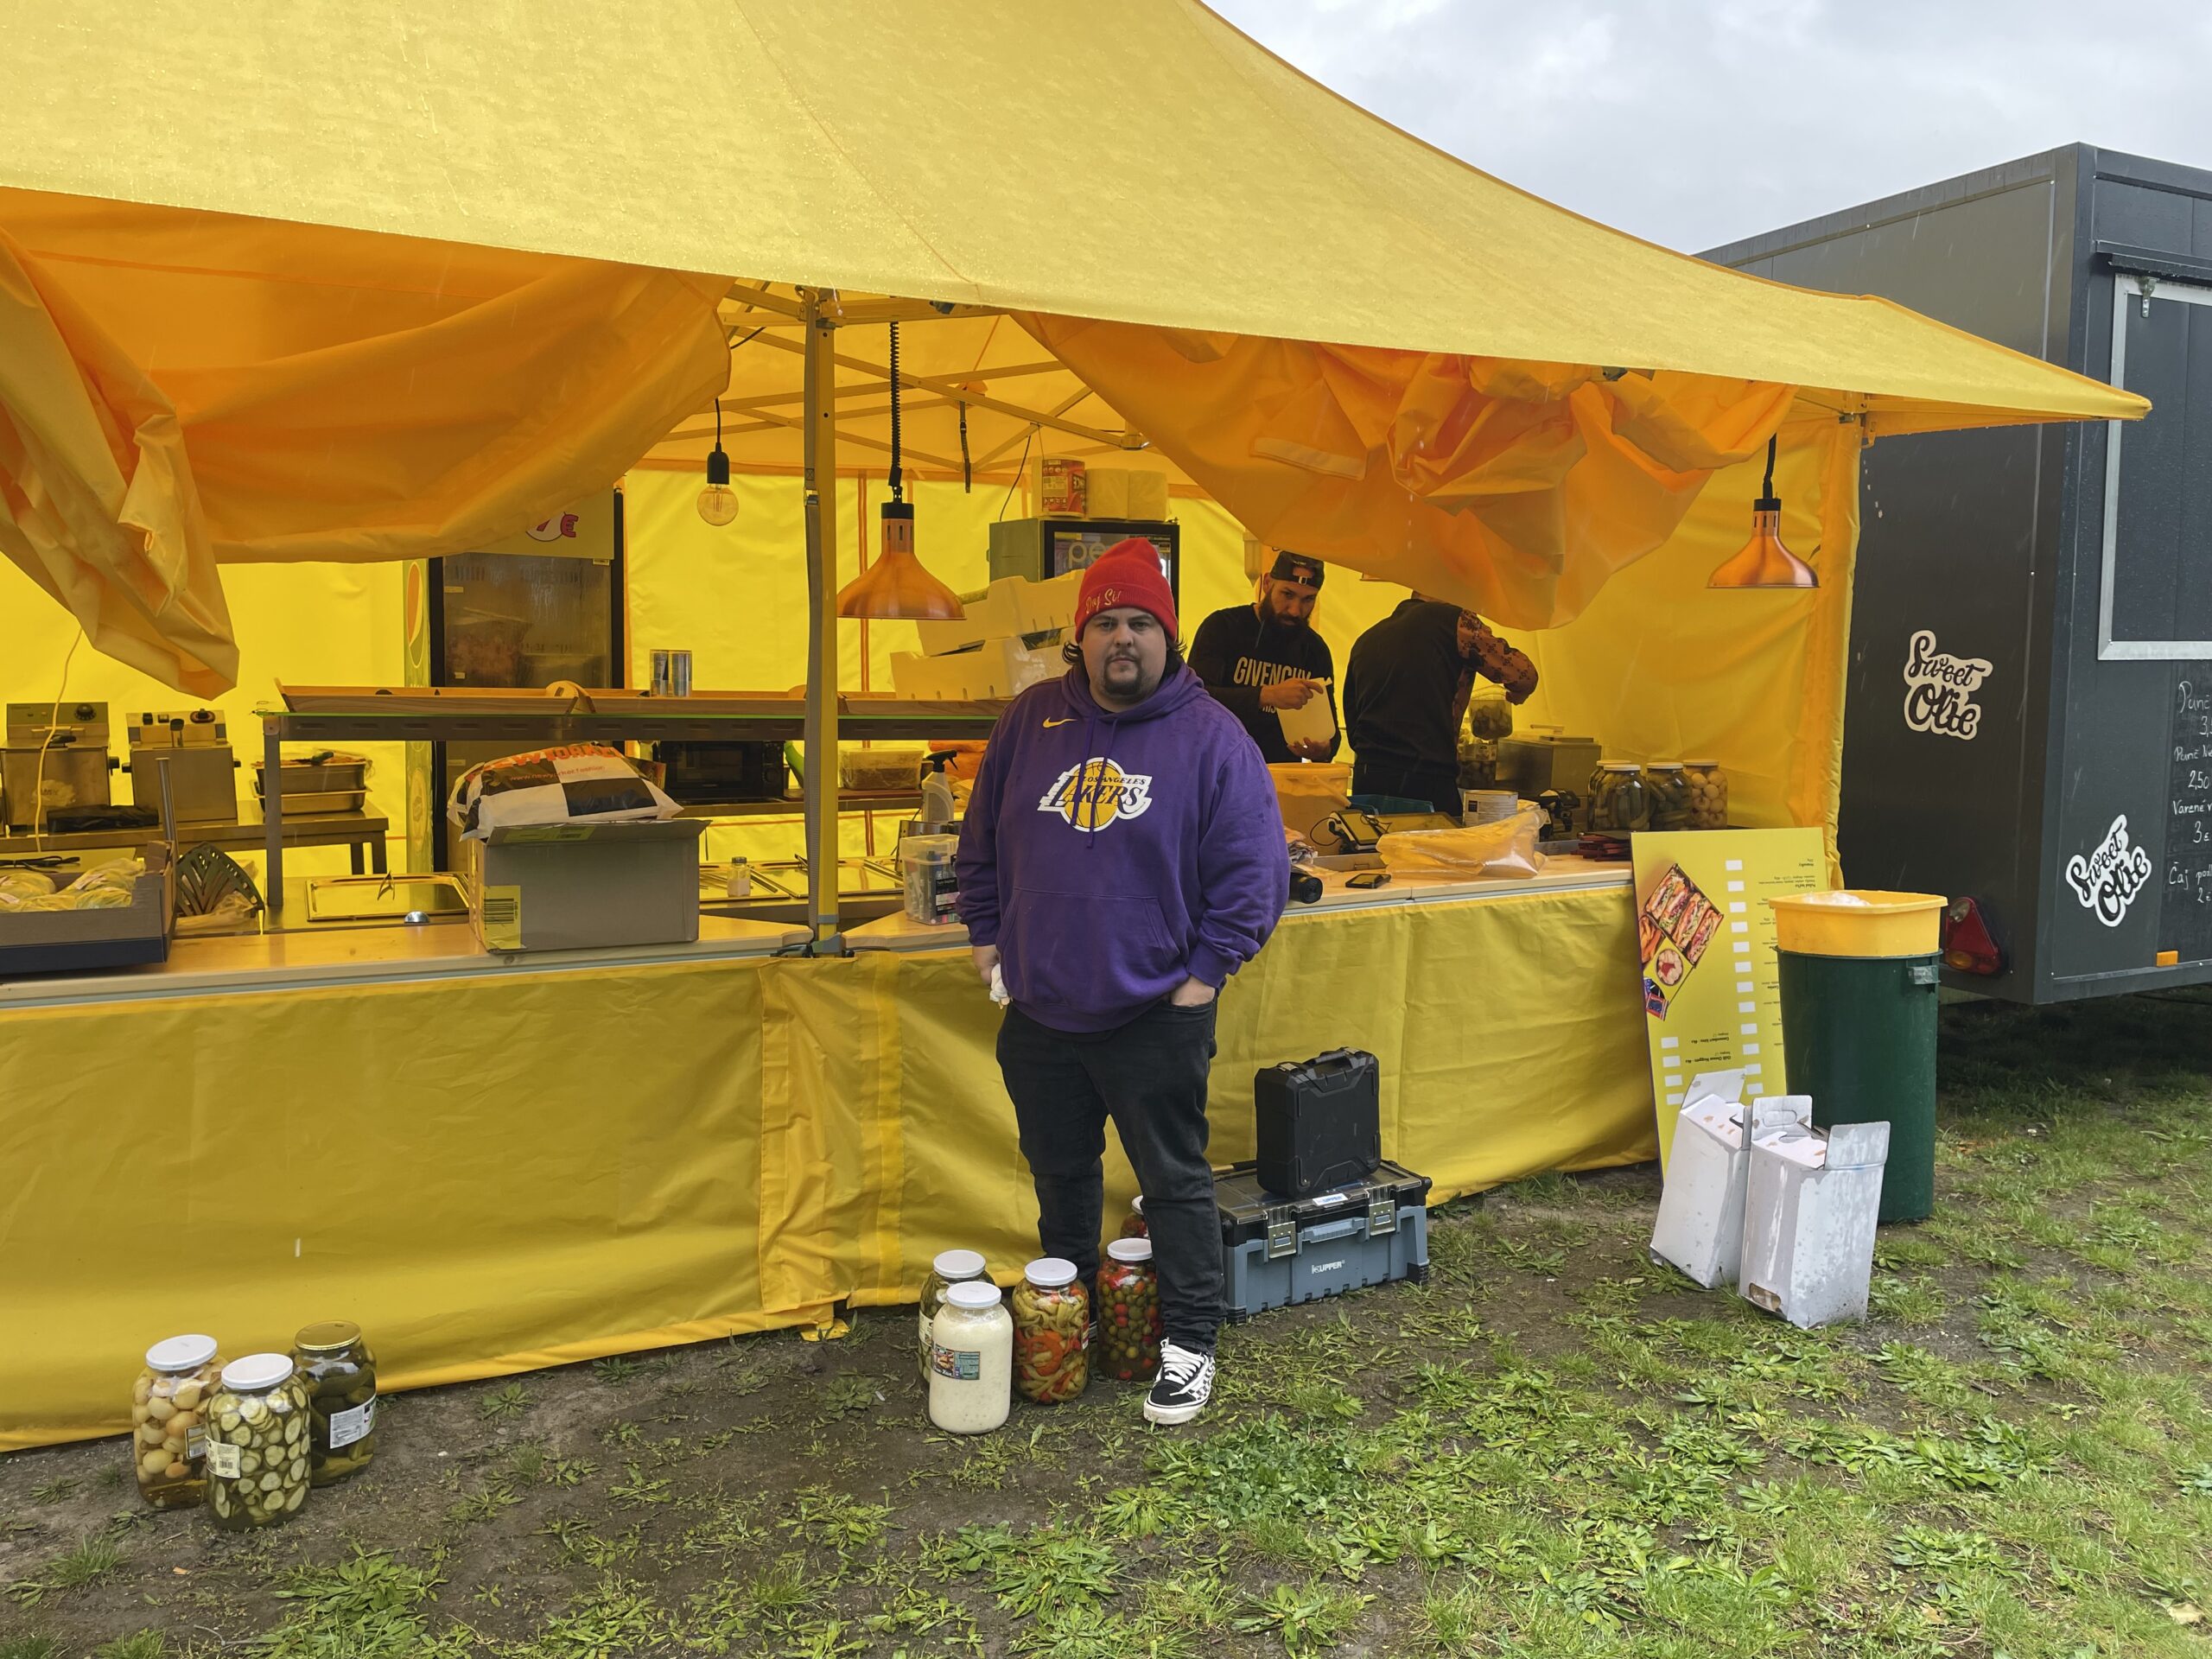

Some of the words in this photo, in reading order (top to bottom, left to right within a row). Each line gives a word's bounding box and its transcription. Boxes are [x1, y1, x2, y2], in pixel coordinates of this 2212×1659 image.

[1908, 635, 1986, 687] Sweet
[1908, 683, 1977, 736] Olie
[1042, 775, 1145, 815] LAKERS
[1102, 776, 1147, 785] ANGELES
[2070, 822, 2123, 902] Sweet
[2098, 852, 2148, 922] Olie
